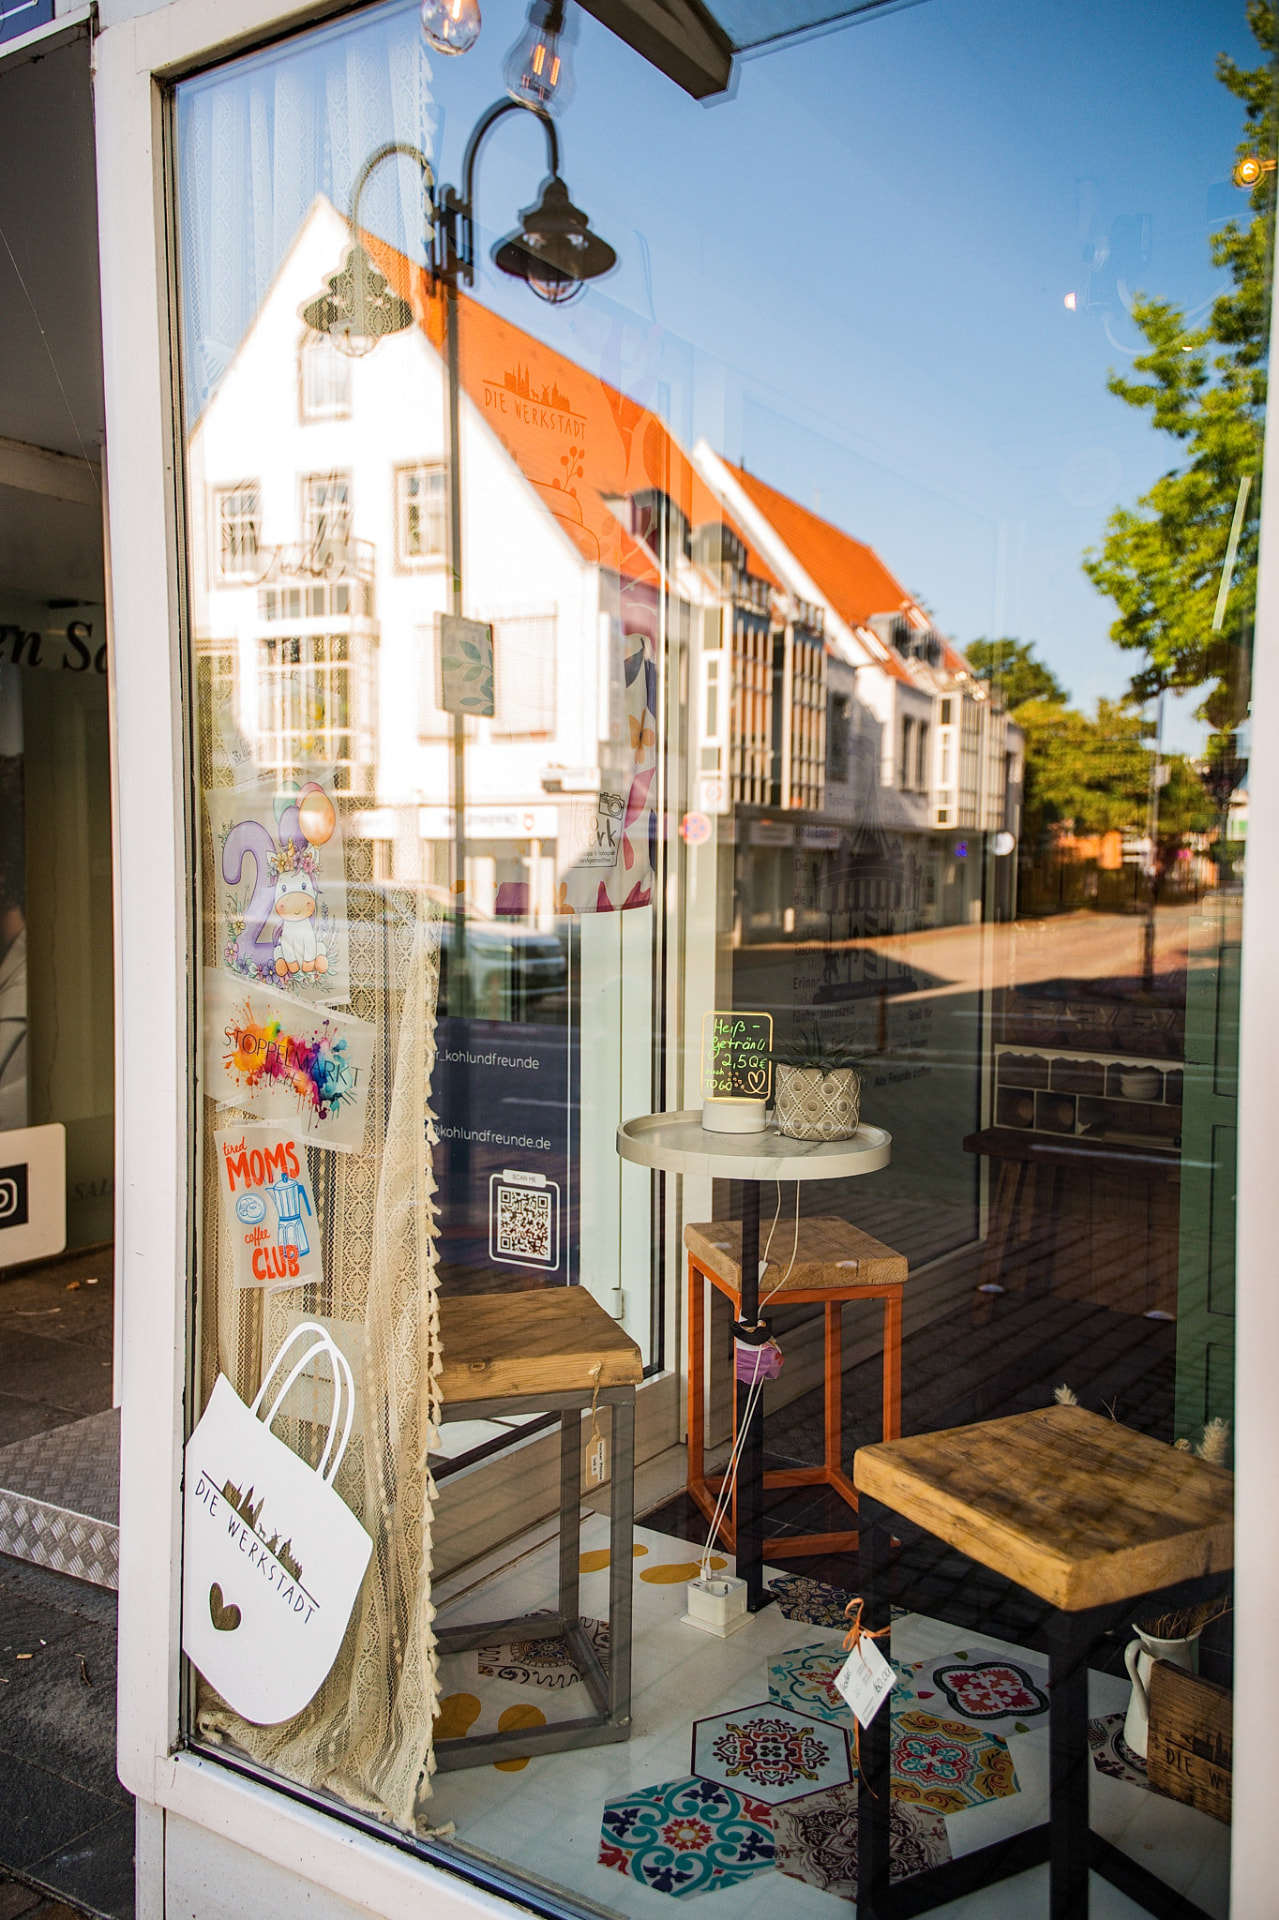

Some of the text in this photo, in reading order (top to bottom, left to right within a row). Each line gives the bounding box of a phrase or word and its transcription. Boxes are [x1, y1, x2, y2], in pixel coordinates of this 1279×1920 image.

[484, 387, 587, 441] DIE WERKSTADT
[222, 1025, 364, 1087] STOPPELMARKT
[222, 1135, 249, 1157] tired
[225, 1141, 301, 1193] MOMS
[511, 1173, 537, 1183] SCAN ME
[244, 1227, 271, 1247] coffee
[251, 1244, 301, 1281] CLUB
[194, 1478, 316, 1625] DIE WERKSTADT
[1166, 1746, 1195, 1779] DIE
